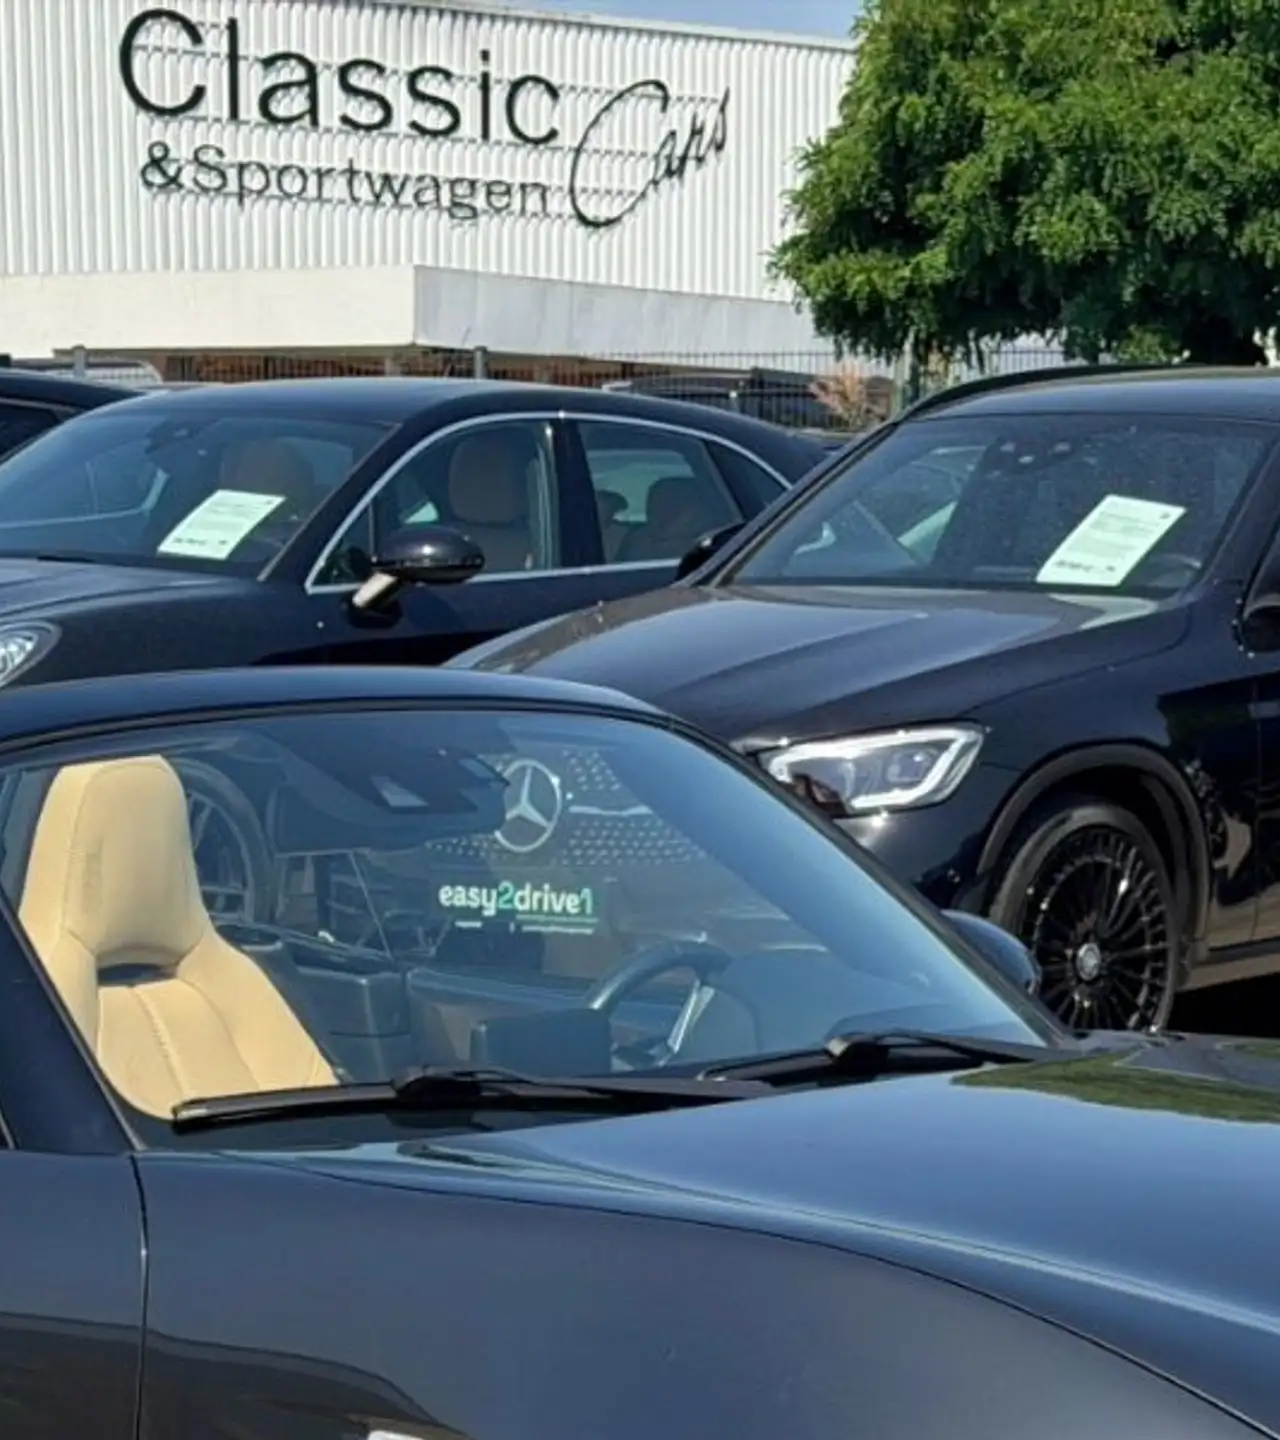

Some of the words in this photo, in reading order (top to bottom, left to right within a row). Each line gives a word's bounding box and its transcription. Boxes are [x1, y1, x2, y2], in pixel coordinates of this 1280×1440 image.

[120, 9, 561, 145] Classic
[570, 79, 731, 228] Cars
[139, 140, 550, 220] &Sportwagen
[438, 881, 593, 916] easy2drive1
